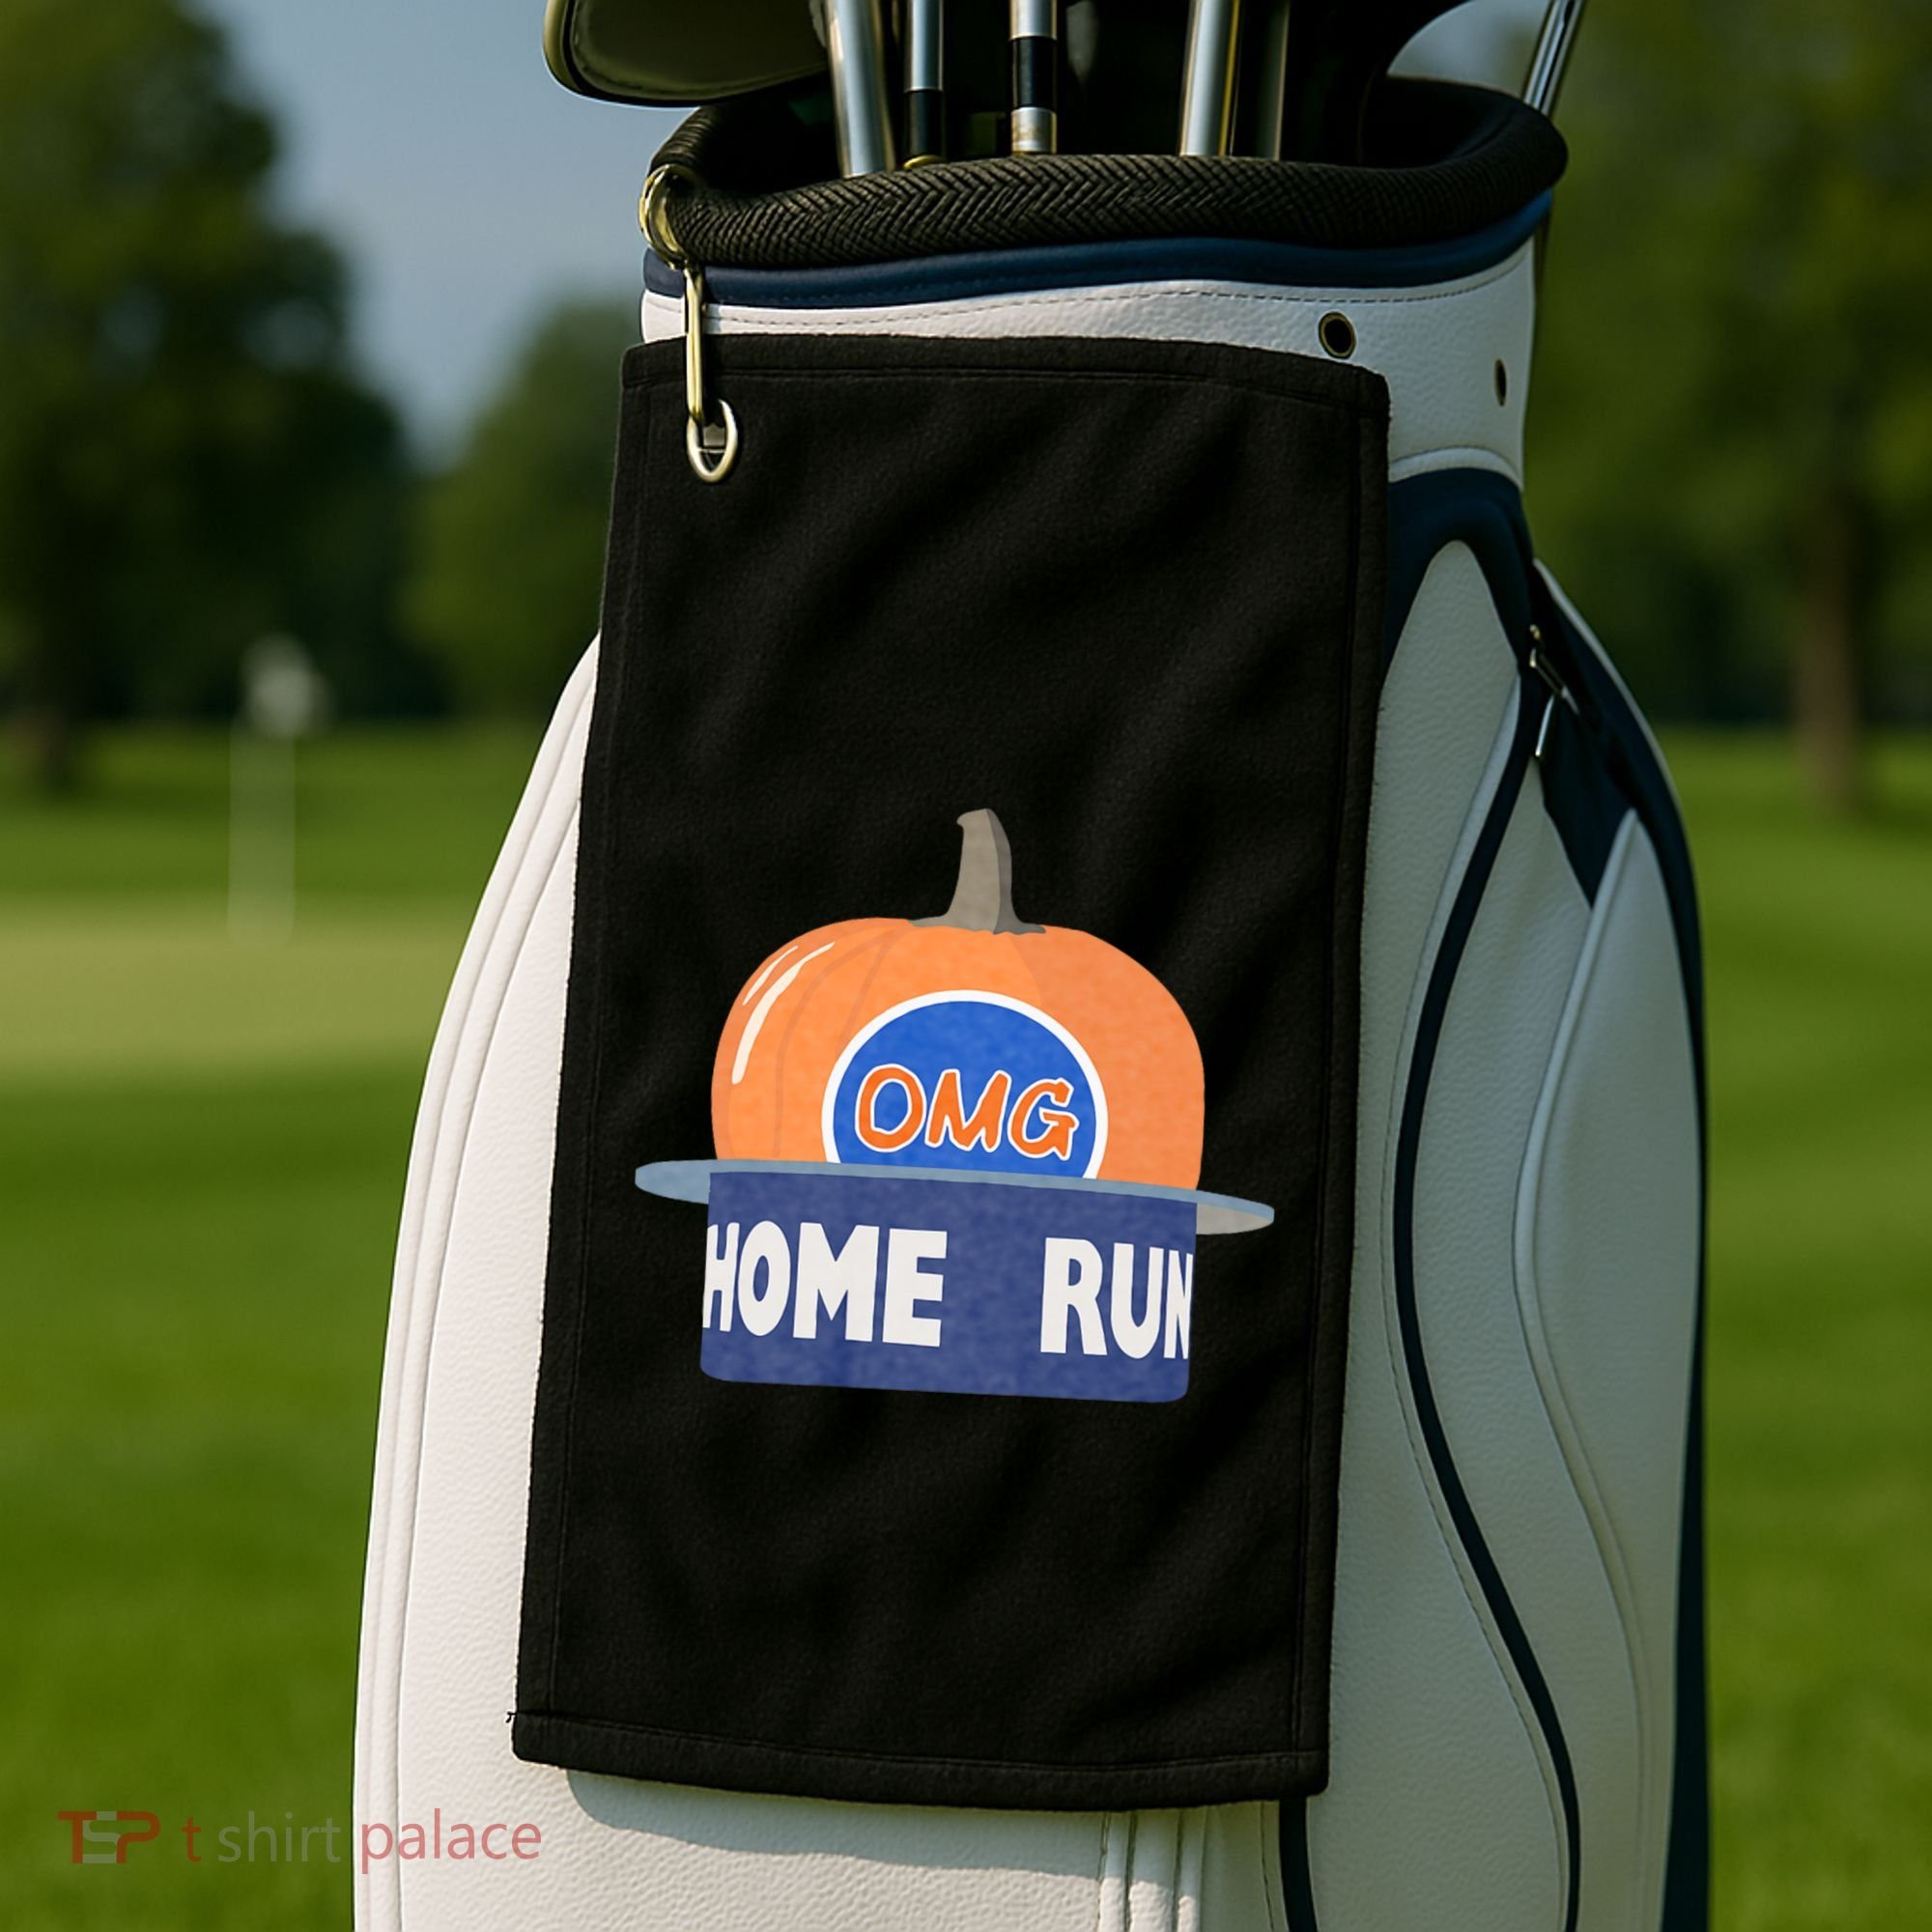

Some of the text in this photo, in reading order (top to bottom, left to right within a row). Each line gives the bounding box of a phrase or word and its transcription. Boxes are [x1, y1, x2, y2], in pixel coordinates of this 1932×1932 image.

[855, 1064, 1078, 1160] OMG
[702, 1220, 1193, 1358] HOME RUN
